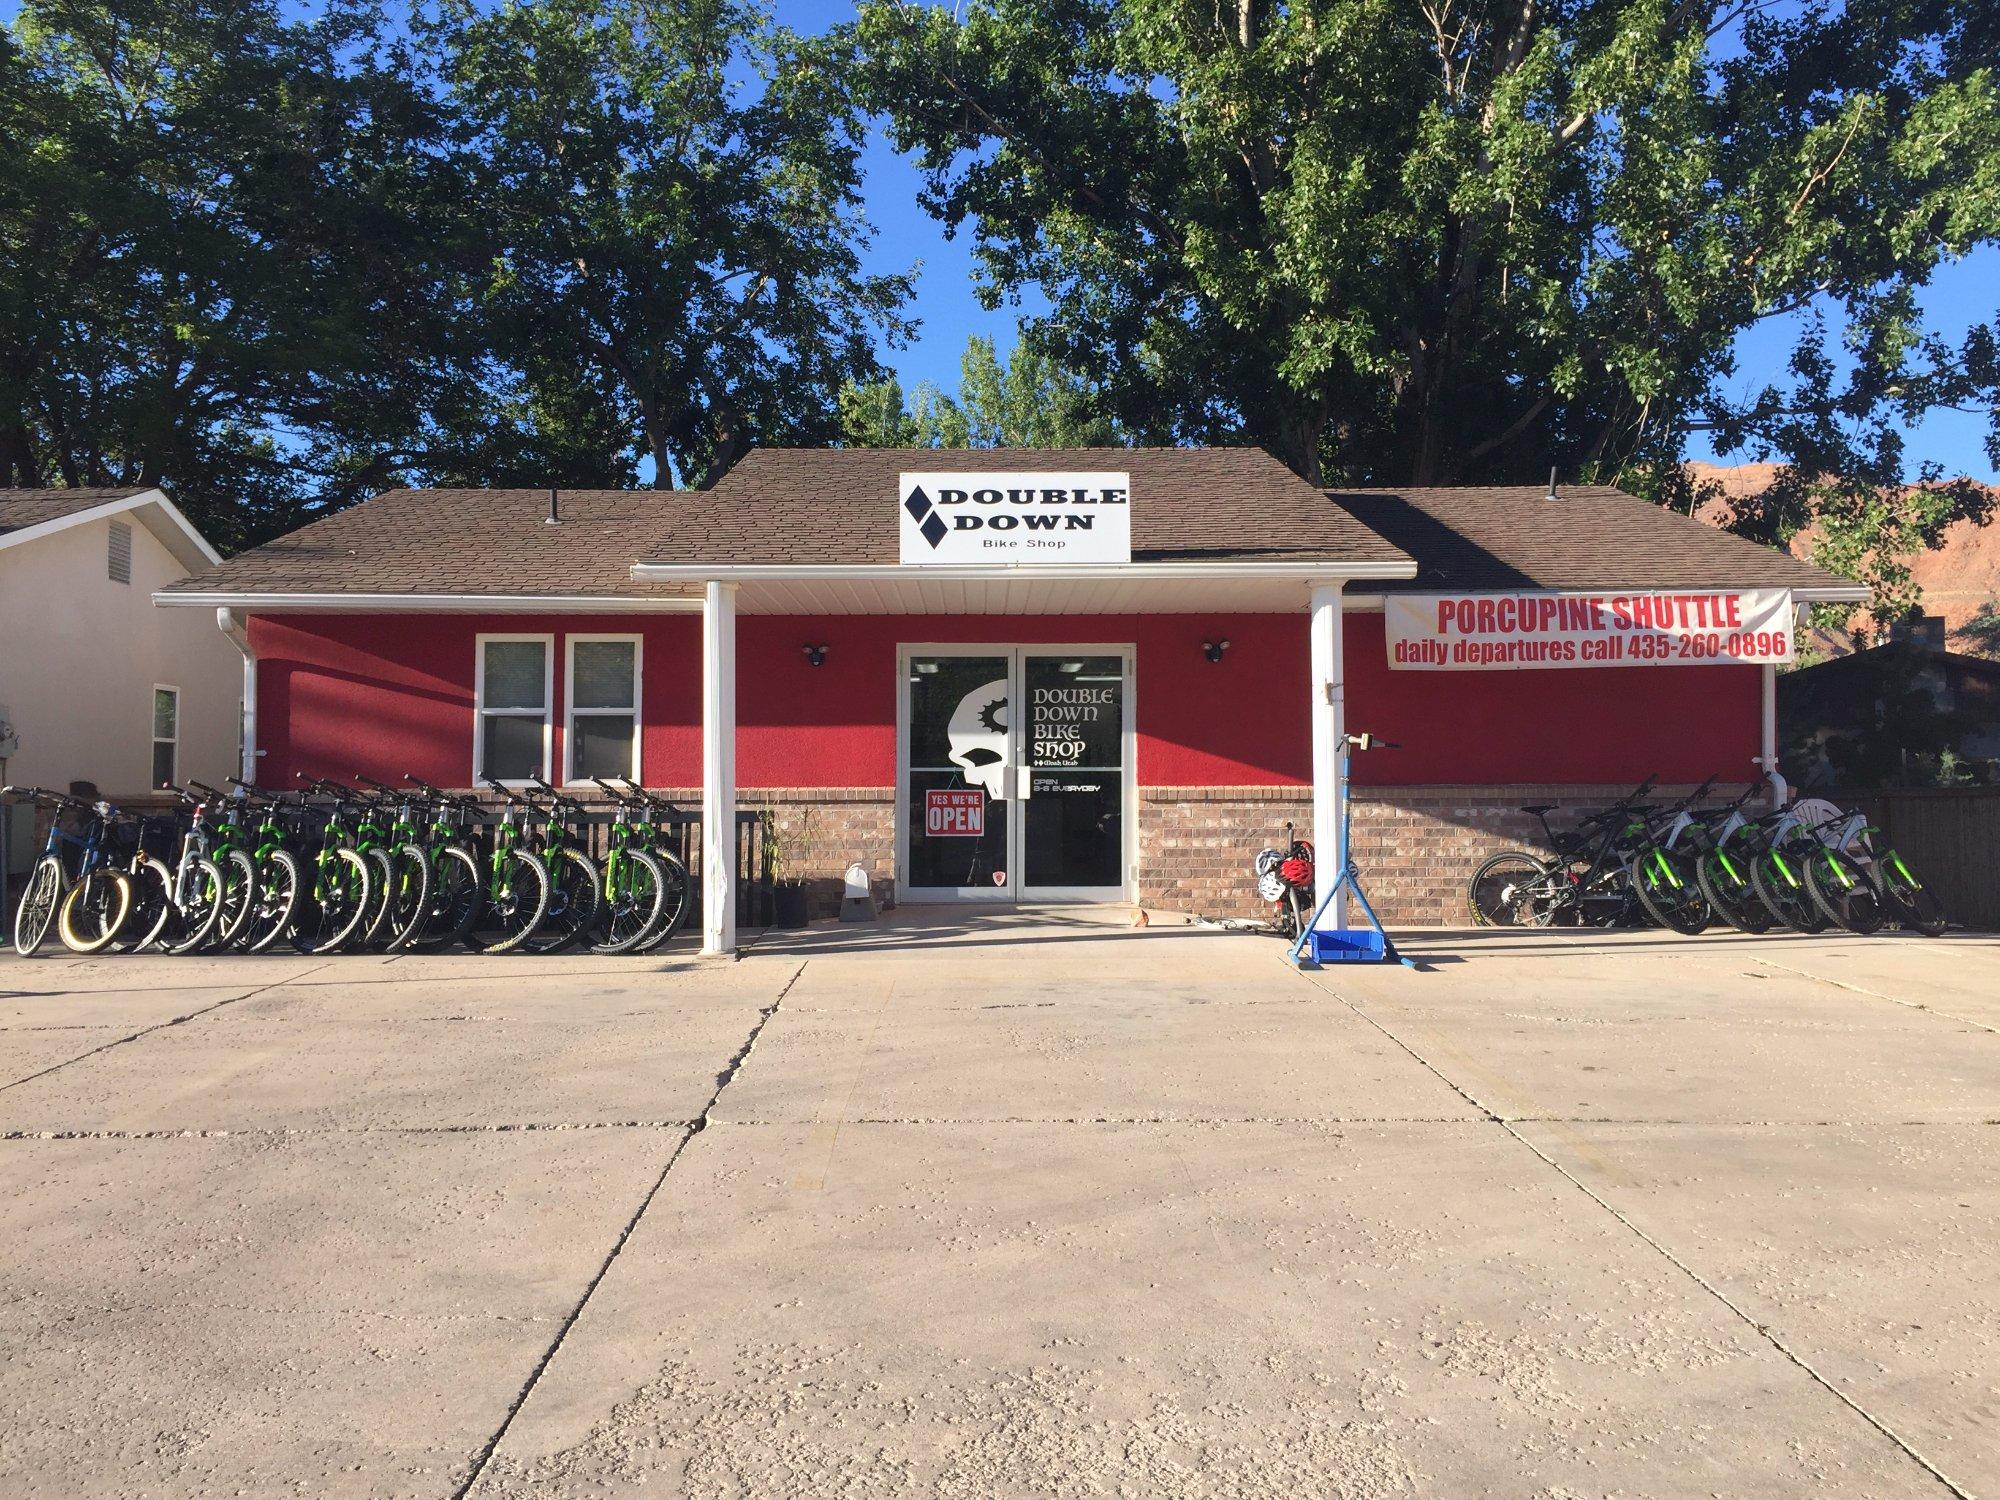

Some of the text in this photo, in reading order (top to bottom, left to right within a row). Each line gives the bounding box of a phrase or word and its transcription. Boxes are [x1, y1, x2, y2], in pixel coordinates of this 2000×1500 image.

[938, 489, 1127, 505] DOUBLE
[953, 515, 1096, 531] DOWN
[983, 539, 1066, 549] Bike Shop
[1437, 594, 1742, 634] PORCUPINE SHUTTLE
[1395, 631, 1786, 665] daily departures call 435-260-0896
[1033, 688, 1114, 704] DOUBLE
[1033, 706, 1098, 722] DOWN
[1033, 723, 1081, 741] BIKE
[1033, 741, 1086, 760] SHOP
[931, 795, 979, 805] YES WE'RE
[928, 807, 981, 831] OPEN
